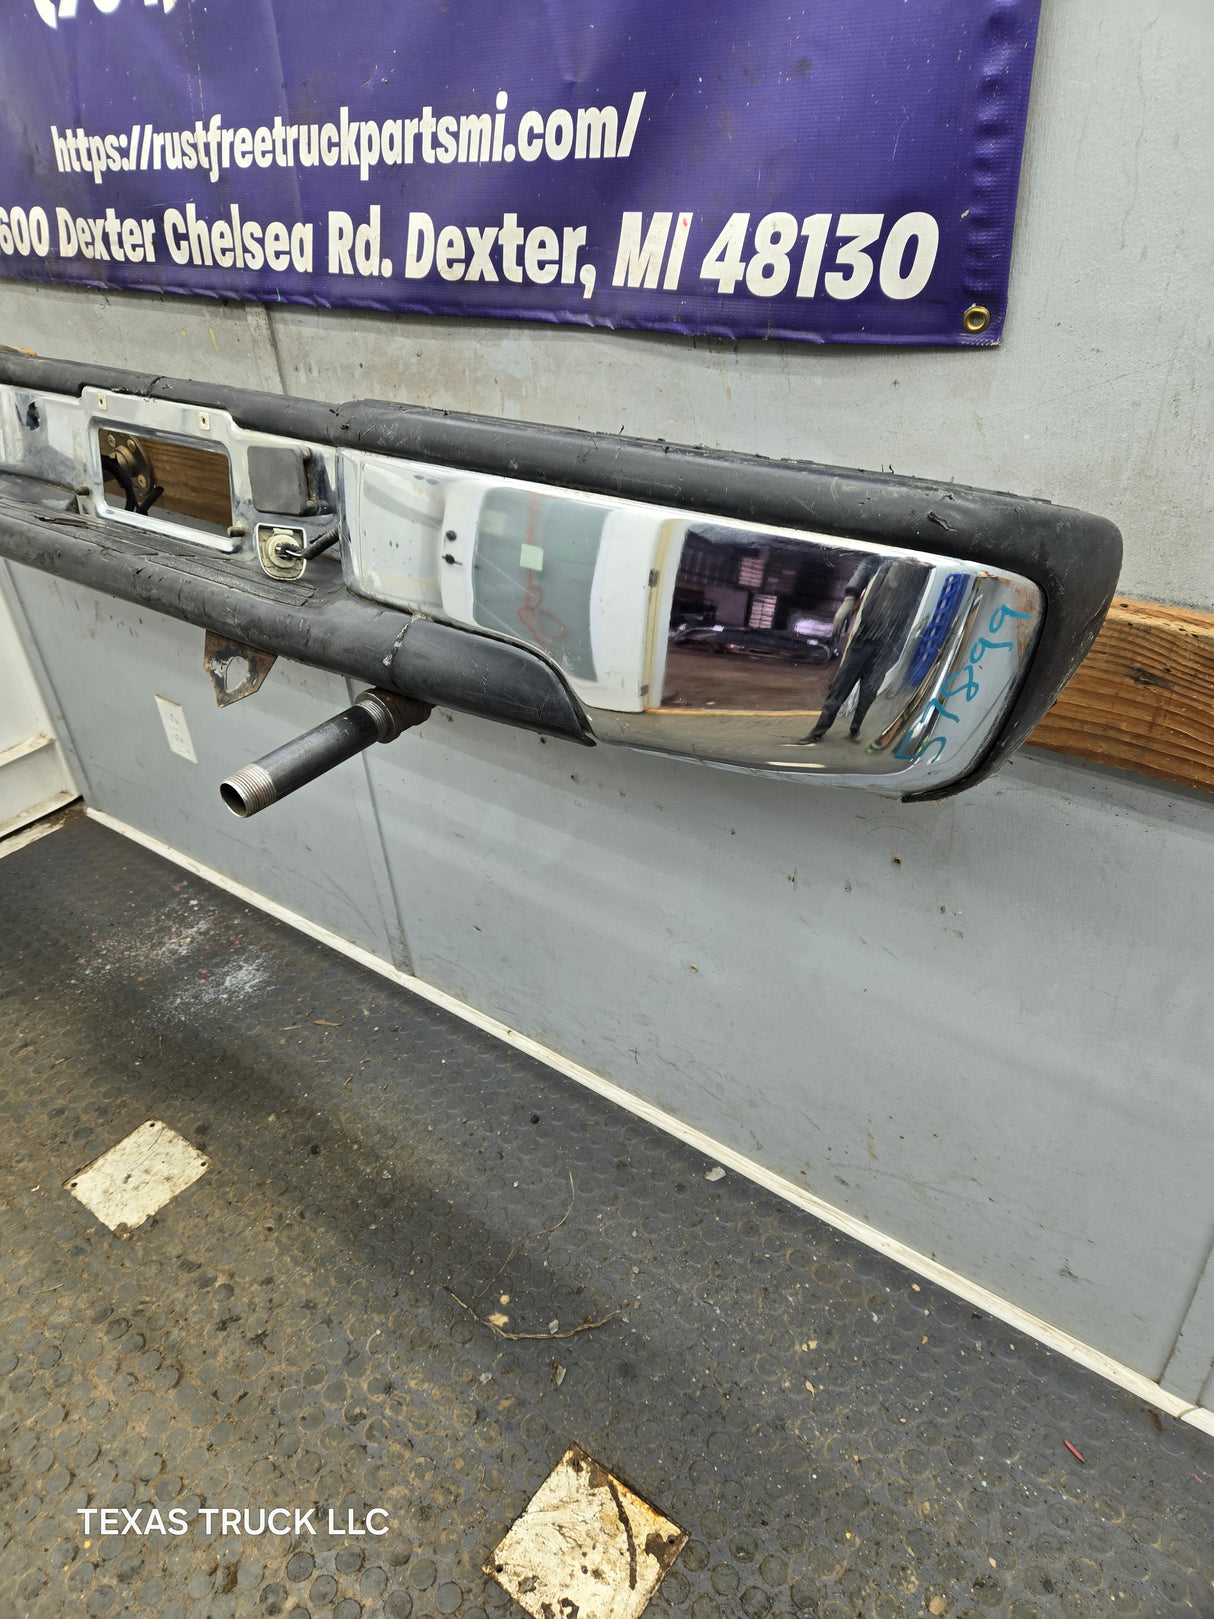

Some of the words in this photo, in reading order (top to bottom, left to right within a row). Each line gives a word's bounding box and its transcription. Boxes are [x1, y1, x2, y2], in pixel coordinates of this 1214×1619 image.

[50, 90, 647, 184] https://rustfreetruckpartsmi.com/
[0, 206, 50, 257] 600
[55, 206, 156, 263] Dexter
[163, 202, 314, 273] Chelsea
[327, 204, 393, 278] Rd.
[404, 211, 597, 299] Dexter,
[611, 211, 694, 290] MI
[699, 211, 940, 300] 48130
